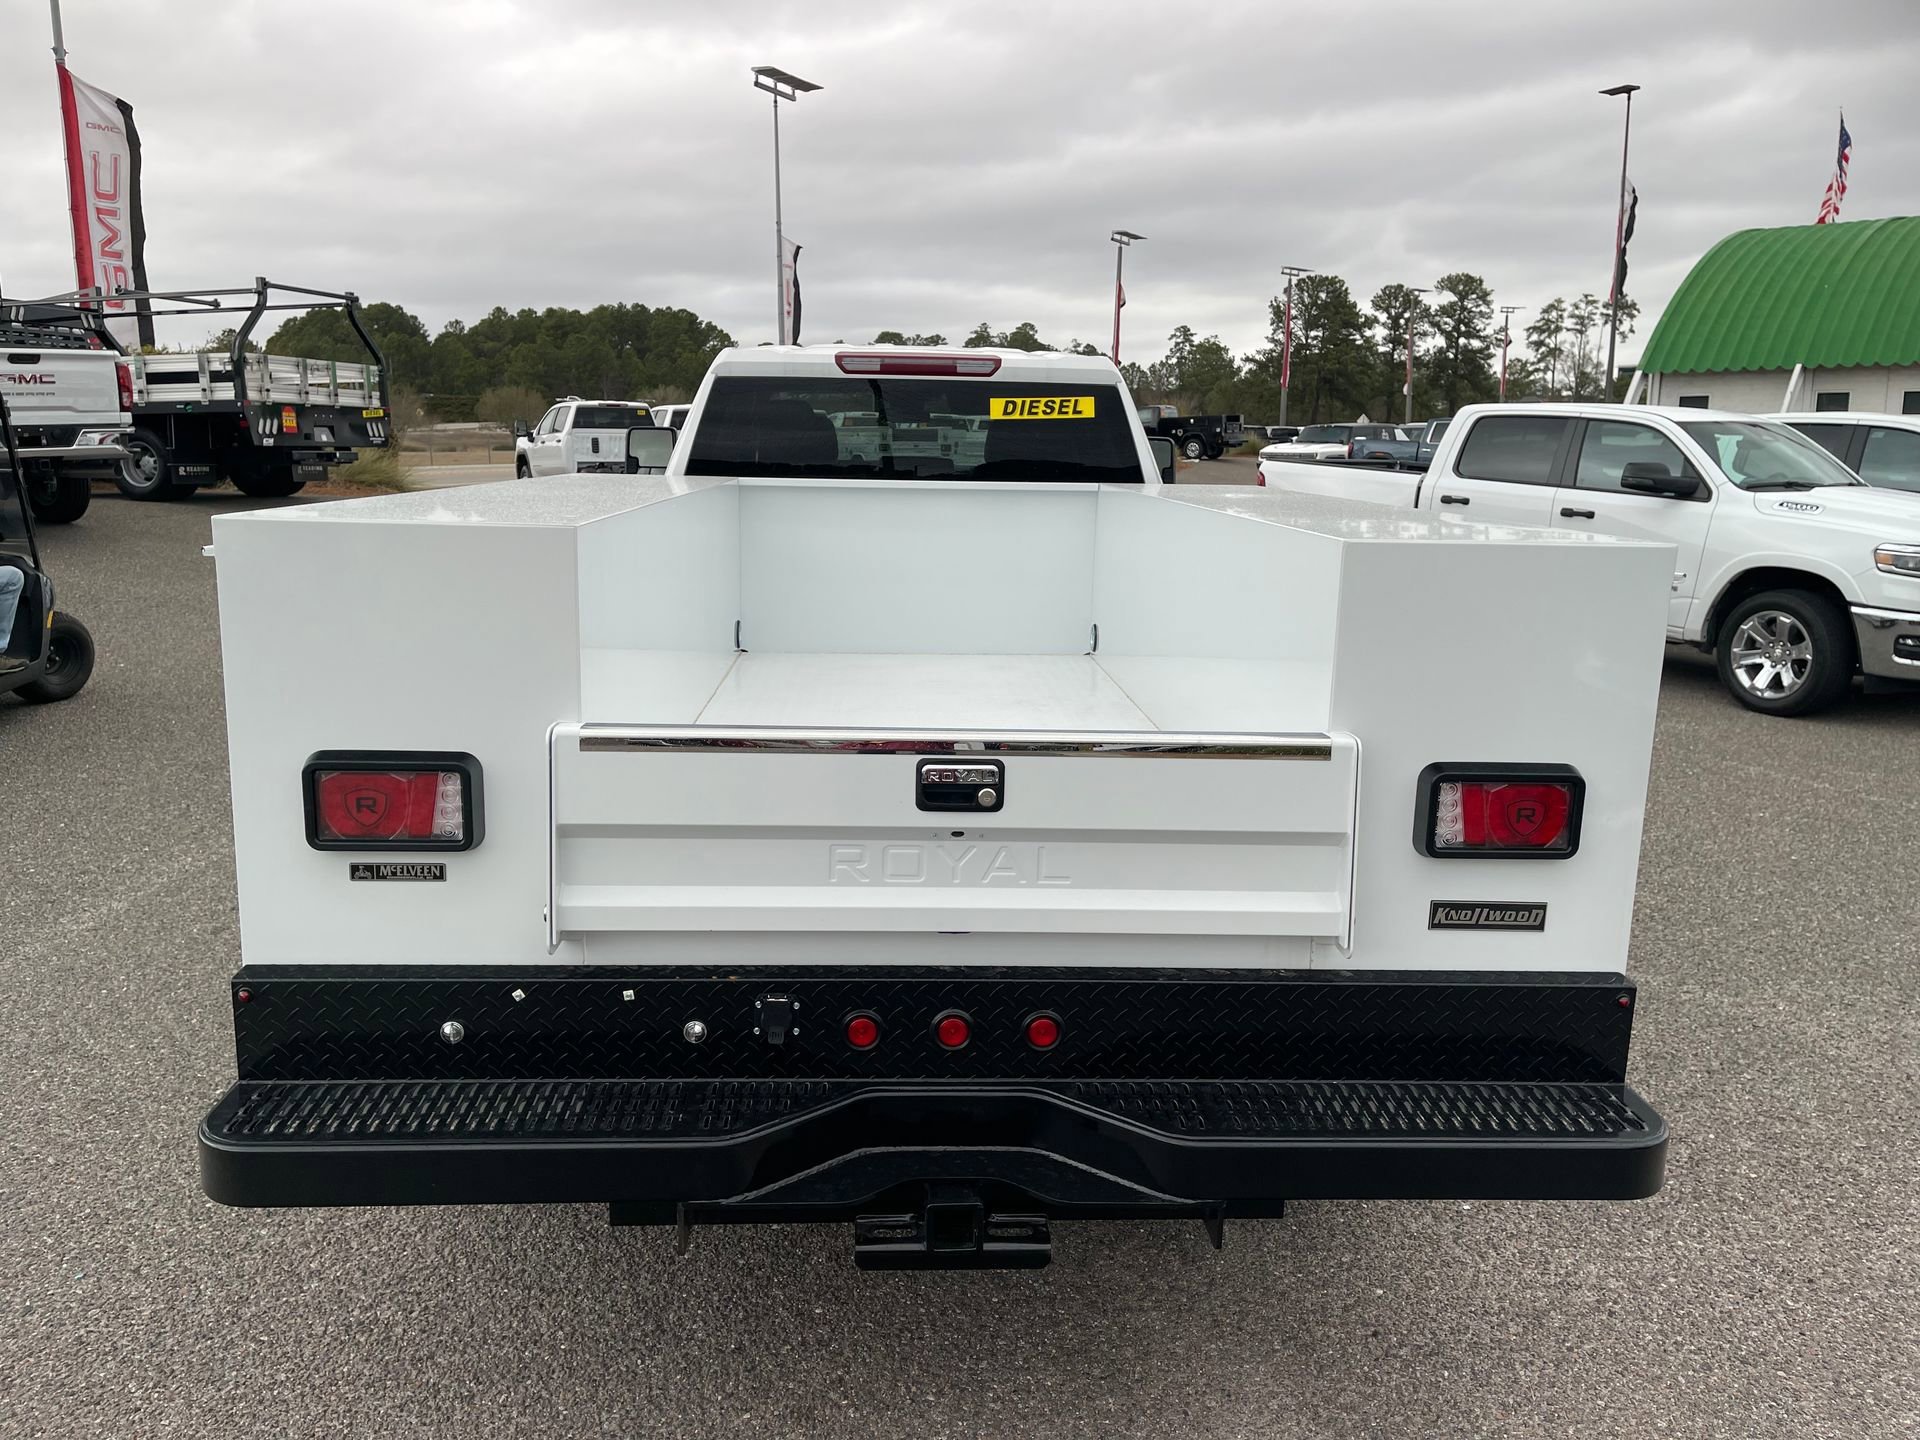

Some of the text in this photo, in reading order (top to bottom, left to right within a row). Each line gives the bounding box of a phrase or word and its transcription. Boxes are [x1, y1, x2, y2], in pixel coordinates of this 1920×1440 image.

[86, 122, 121, 134] GMC
[92, 151, 129, 310] GMC
[1002, 399, 1083, 416] DIESEL
[927, 770, 993, 782] ROYAL
[355, 796, 378, 815] R
[1516, 807, 1536, 824] R
[828, 843, 1072, 885] ROYAL
